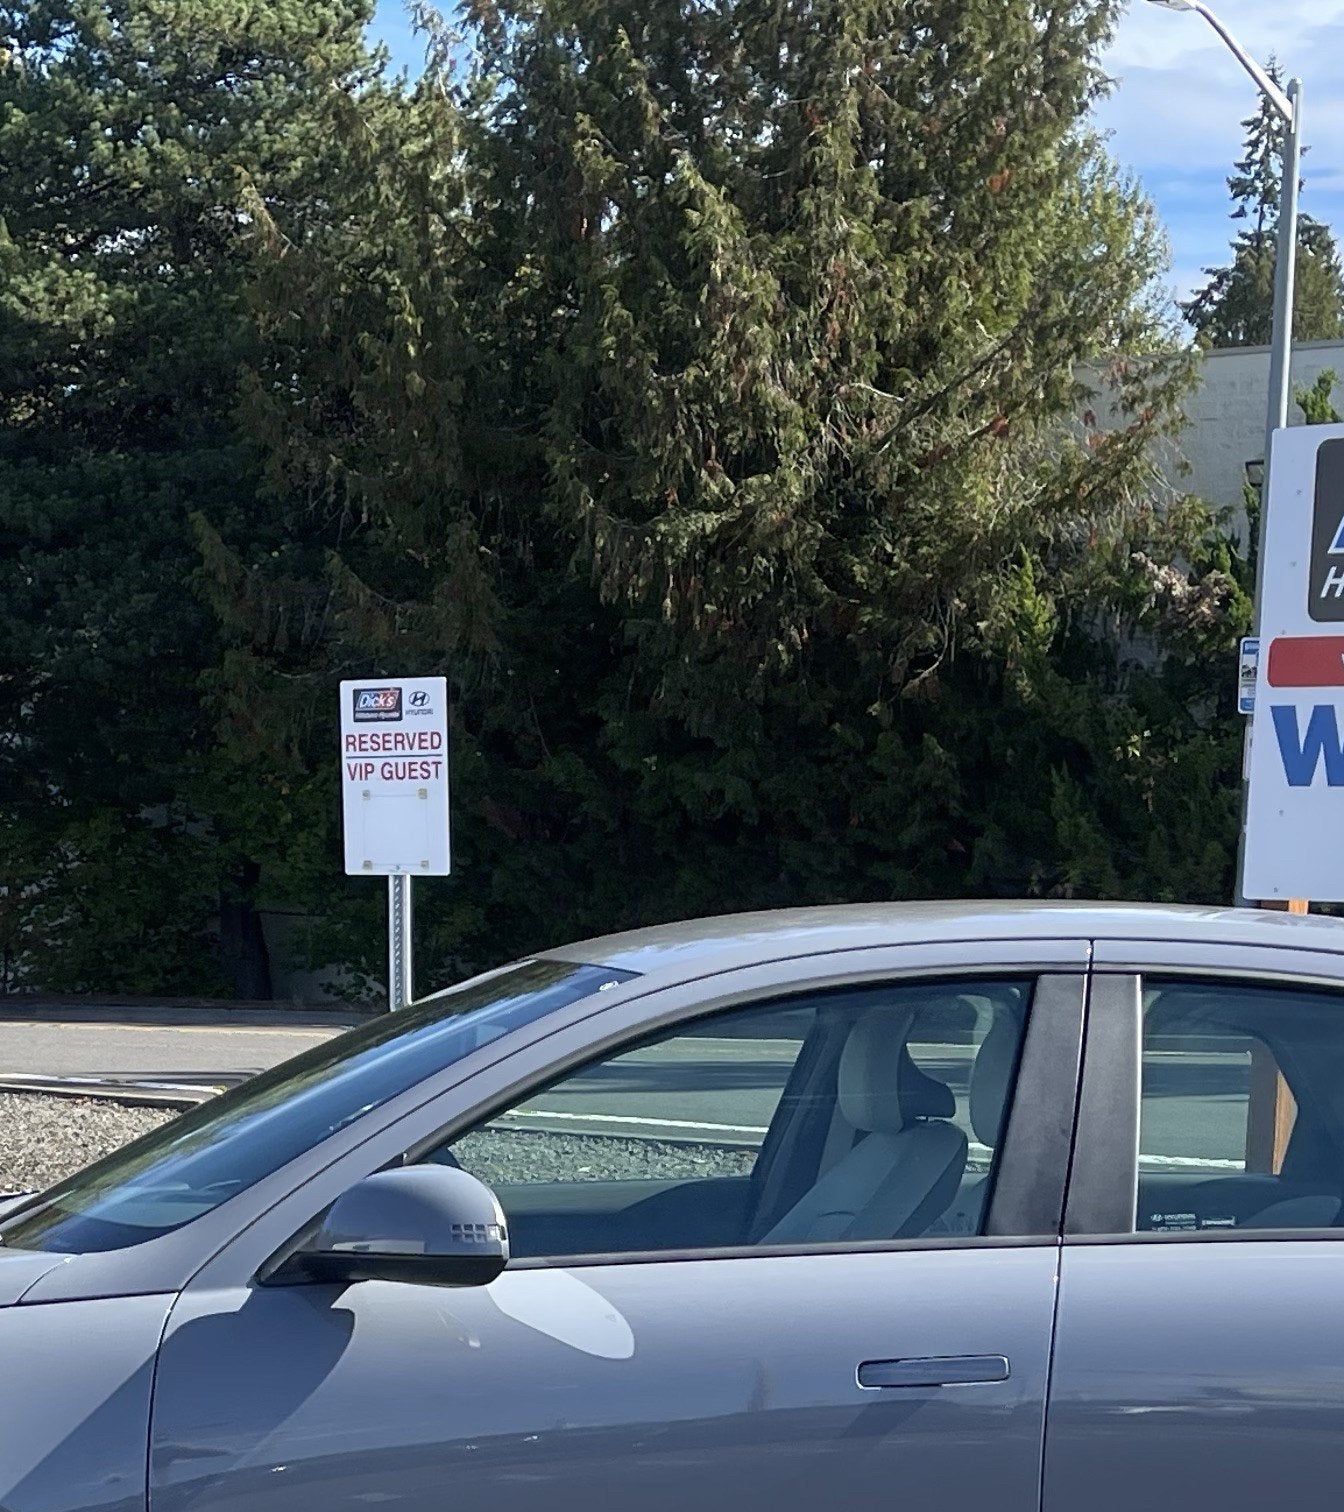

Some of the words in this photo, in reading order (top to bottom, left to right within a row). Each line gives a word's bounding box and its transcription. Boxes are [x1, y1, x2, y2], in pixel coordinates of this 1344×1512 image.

[345, 731, 442, 752] RESERVED
[346, 762, 375, 781] VIP
[380, 760, 442, 781] GUEST
